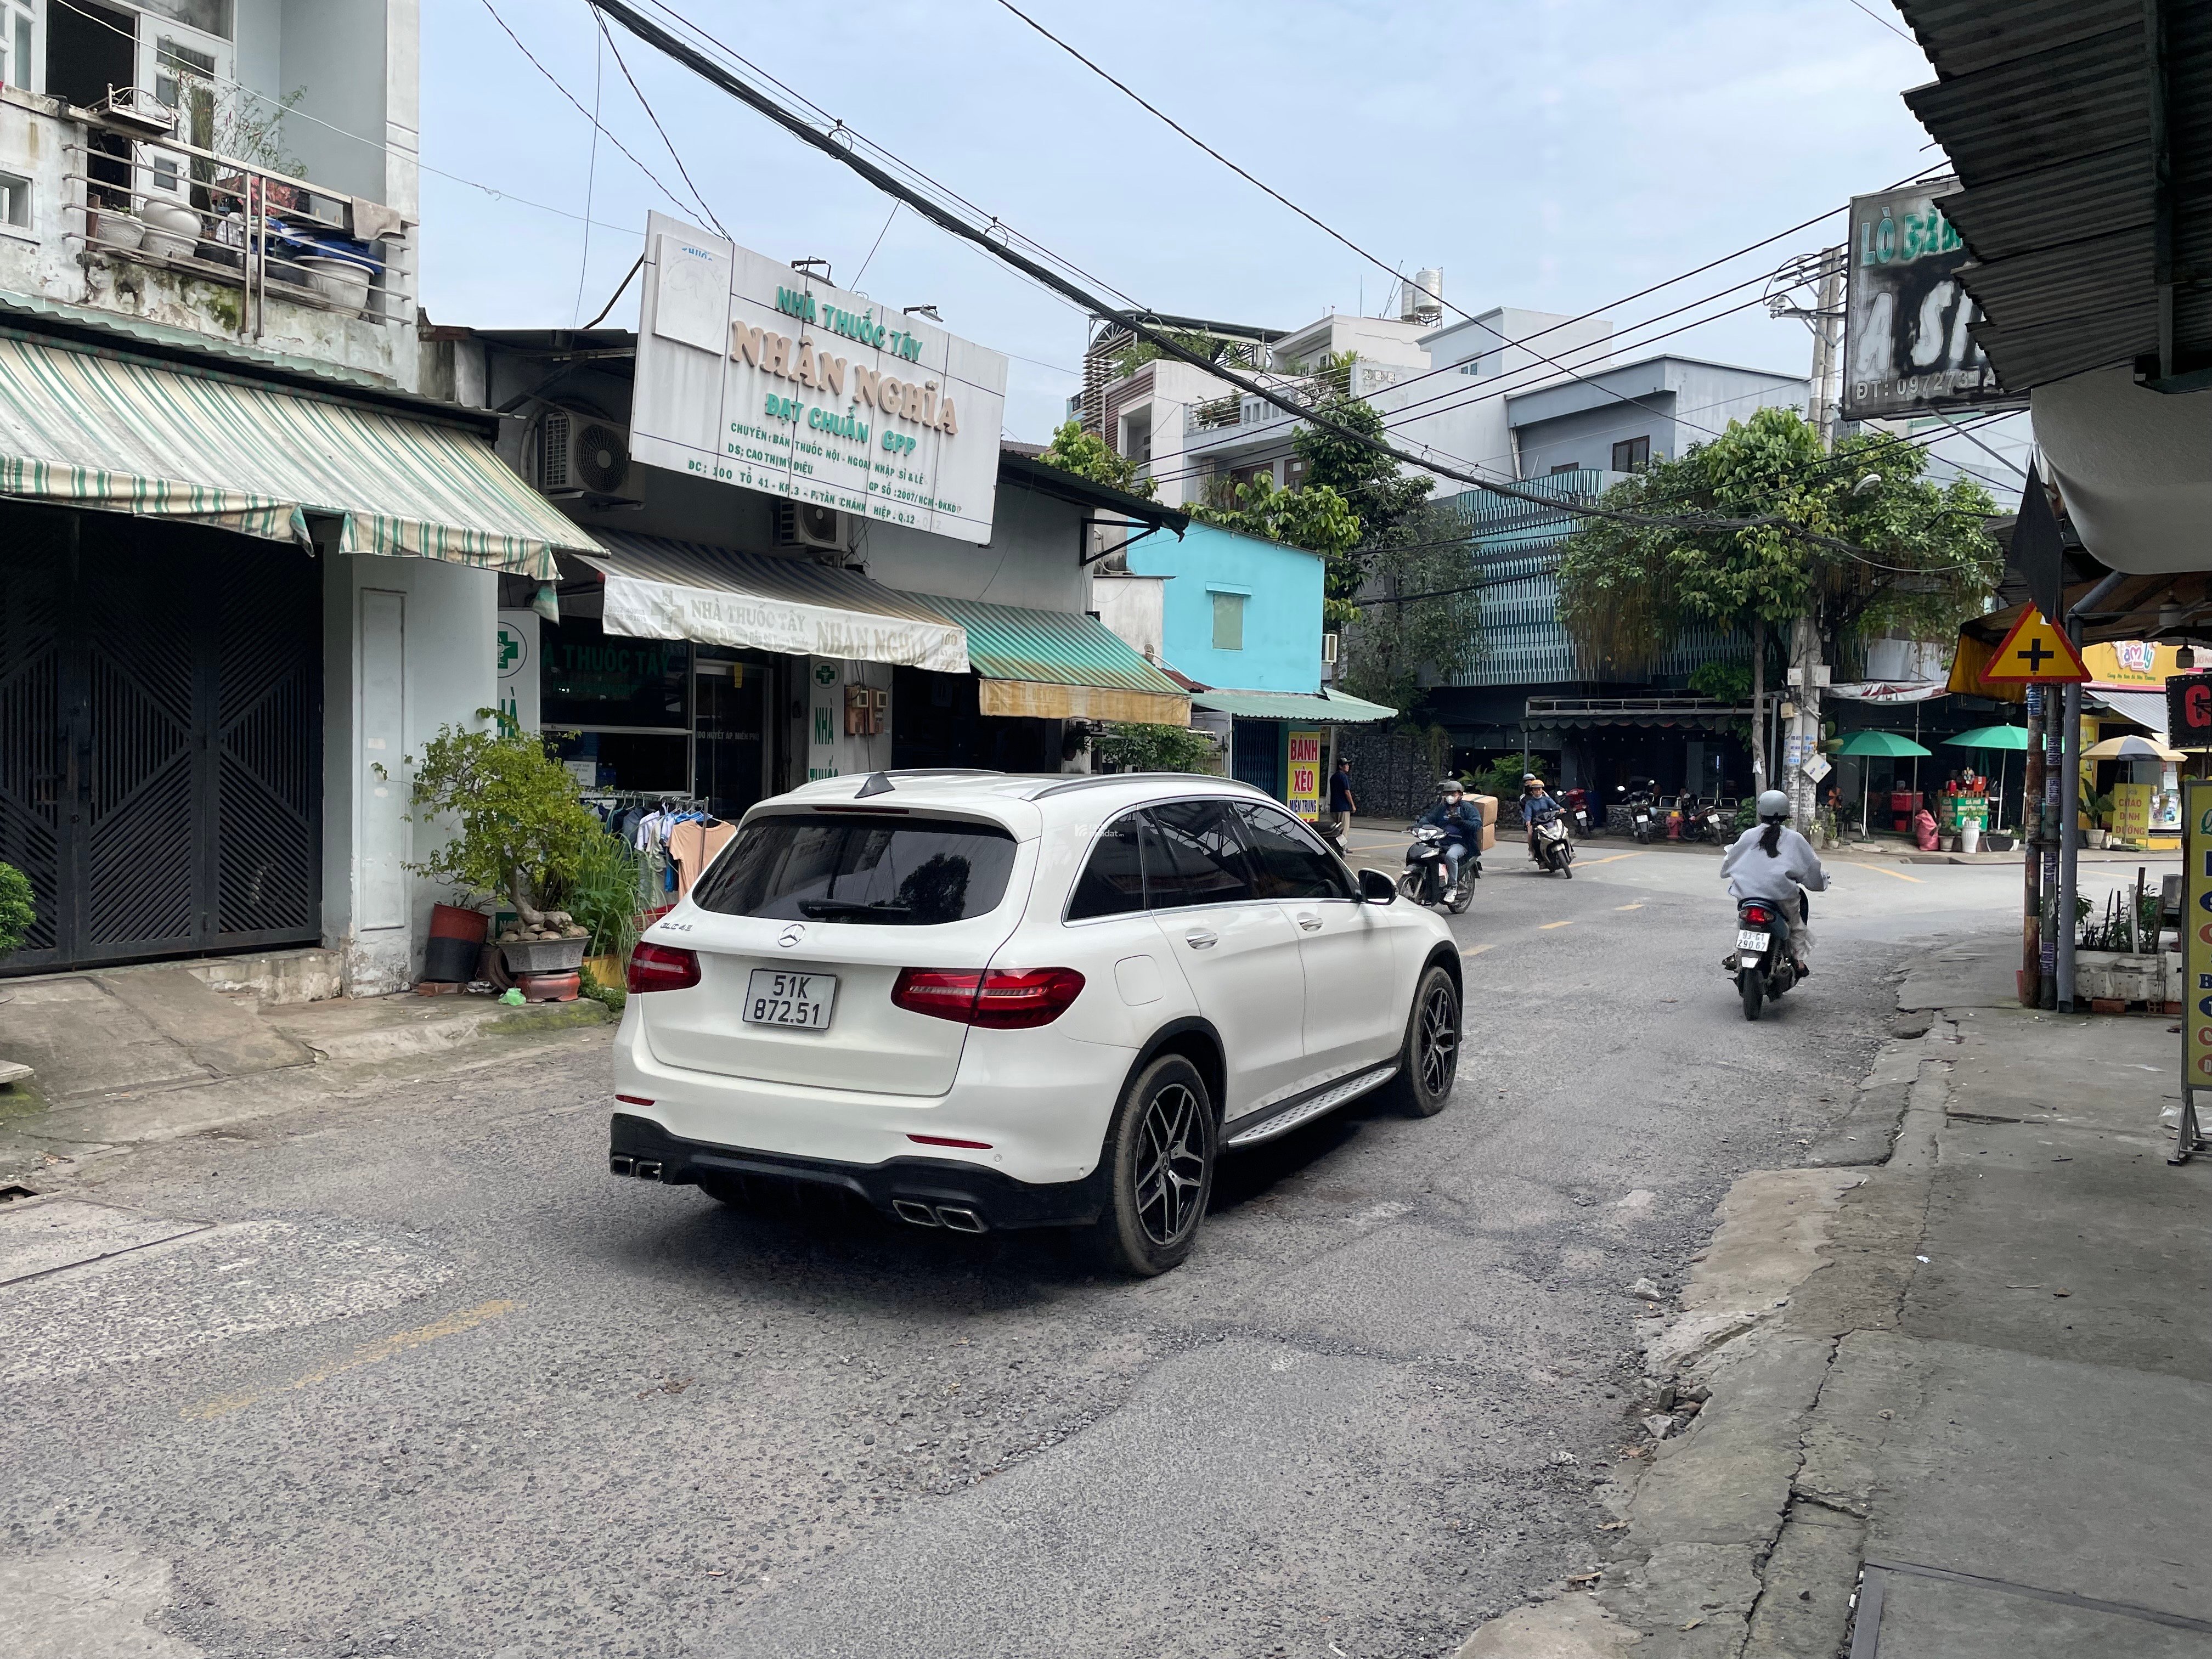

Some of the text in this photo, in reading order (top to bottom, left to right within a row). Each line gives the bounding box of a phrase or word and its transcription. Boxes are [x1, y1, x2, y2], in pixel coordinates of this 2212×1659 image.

[1860, 206, 1895, 267] LÒ
[775, 286, 923, 363] NHÀ THUỐC TÂY
[730, 320, 958, 435] NHÂN NGHĨA
[765, 393, 917, 457] ĐẠT CHUẨN GPP
[746, 448, 763, 461] CAO
[795, 440, 823, 456] THUỐC
[826, 449, 840, 464] NỘI
[848, 455, 870, 472] NGOẠI
[874, 462, 895, 478] NHẬP
[713, 467, 732, 479] 100
[740, 465, 752, 484] TỔ
[758, 477, 769, 488] 41
[840, 496, 866, 513] CHÁNH
[873, 505, 891, 520] HIỆP
[868, 481, 878, 492] GP
[882, 481, 891, 495] SỐ
[690, 597, 723, 622] NHÀ
[727, 602, 775, 629] THUỐC
[777, 610, 806, 632] TÂY
[816, 617, 869, 659] NHÂN
[815, 697, 834, 745] NHÀ
[1290, 735, 1318, 761] BÁNH
[1294, 765, 1313, 792] XÈO
[1302, 799, 1317, 813] TRUNG
[1737, 939, 1766, 951] 290.67
[772, 975, 811, 999] 51K
[753, 998, 820, 1025] 872.51
